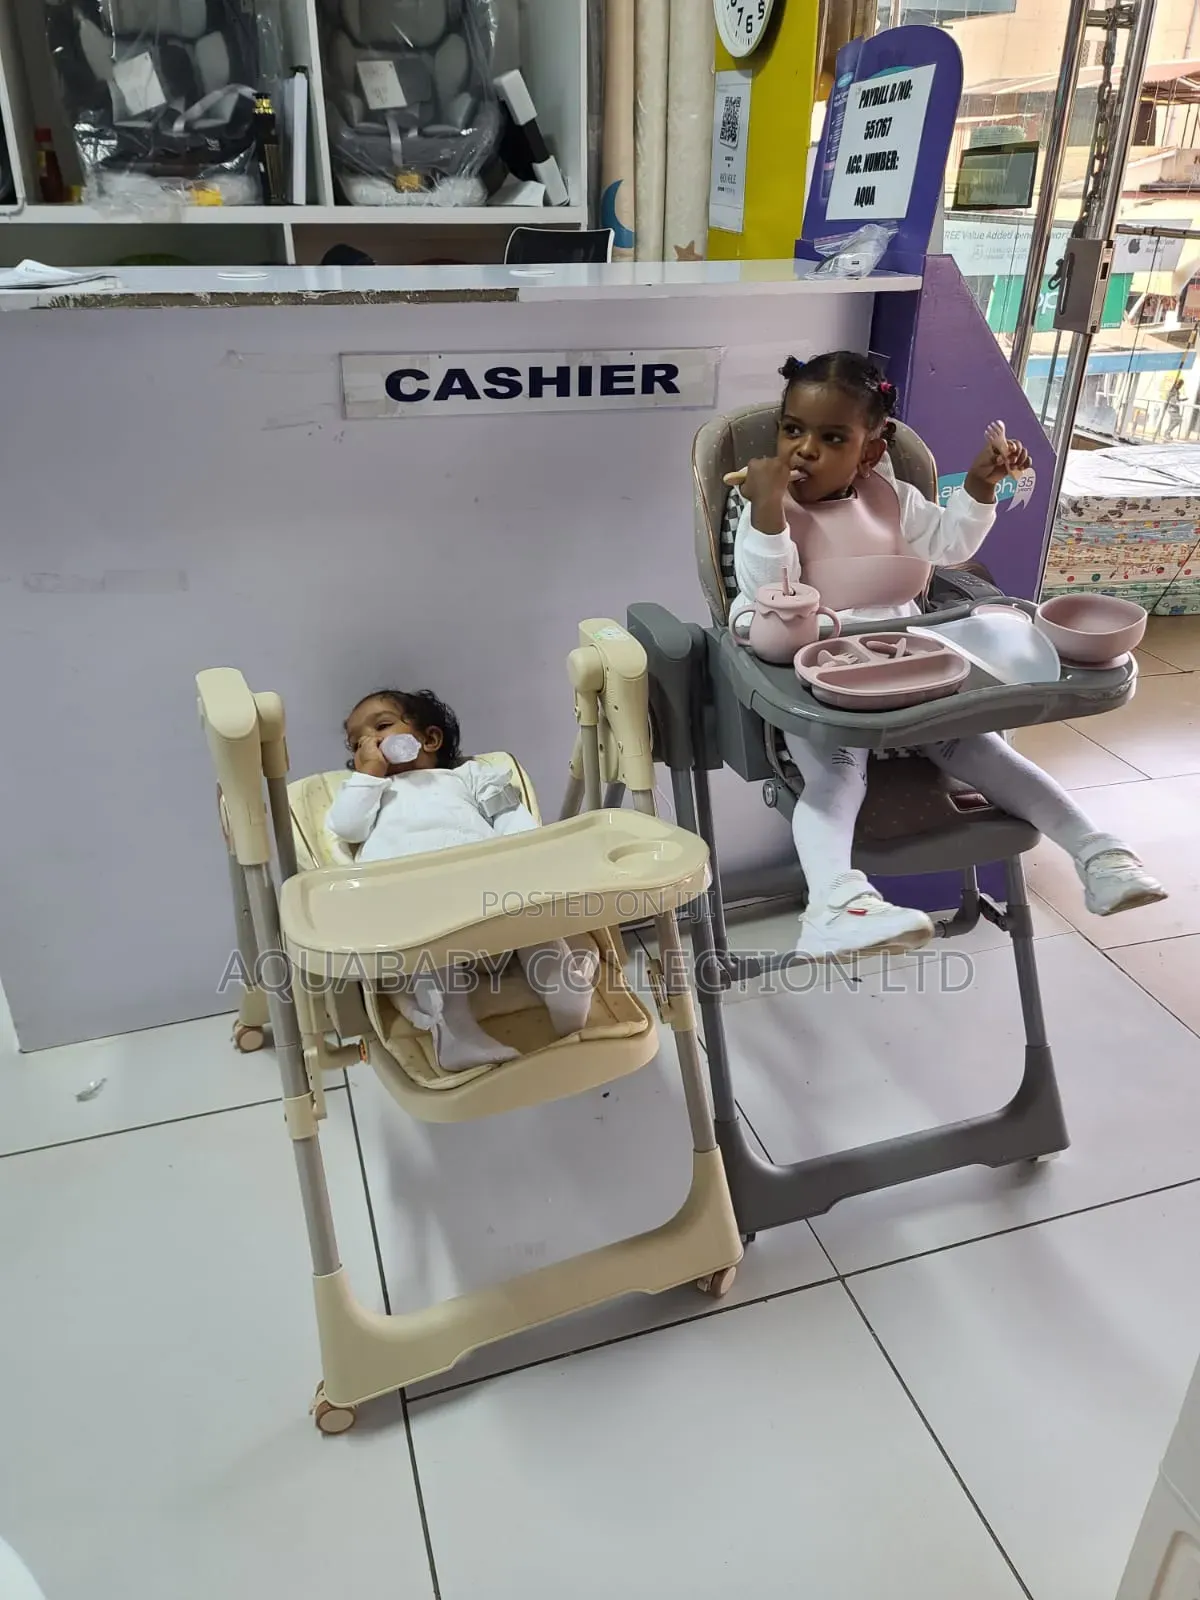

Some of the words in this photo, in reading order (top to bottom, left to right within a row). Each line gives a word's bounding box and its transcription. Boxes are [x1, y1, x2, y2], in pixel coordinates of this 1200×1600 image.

[737, 6, 744, 27] 7
[758, 0, 765, 20] 5
[746, 14, 753, 33] 6
[858, 84, 889, 109] PAYBILL
[864, 117, 893, 140] 551767
[845, 154, 862, 175] ACC.
[862, 150, 900, 173] NUMBER:
[853, 186, 876, 208] AQUA
[944, 229, 961, 240] REE
[385, 363, 681, 402] CASHIER
[1018, 476, 1034, 488] 35
